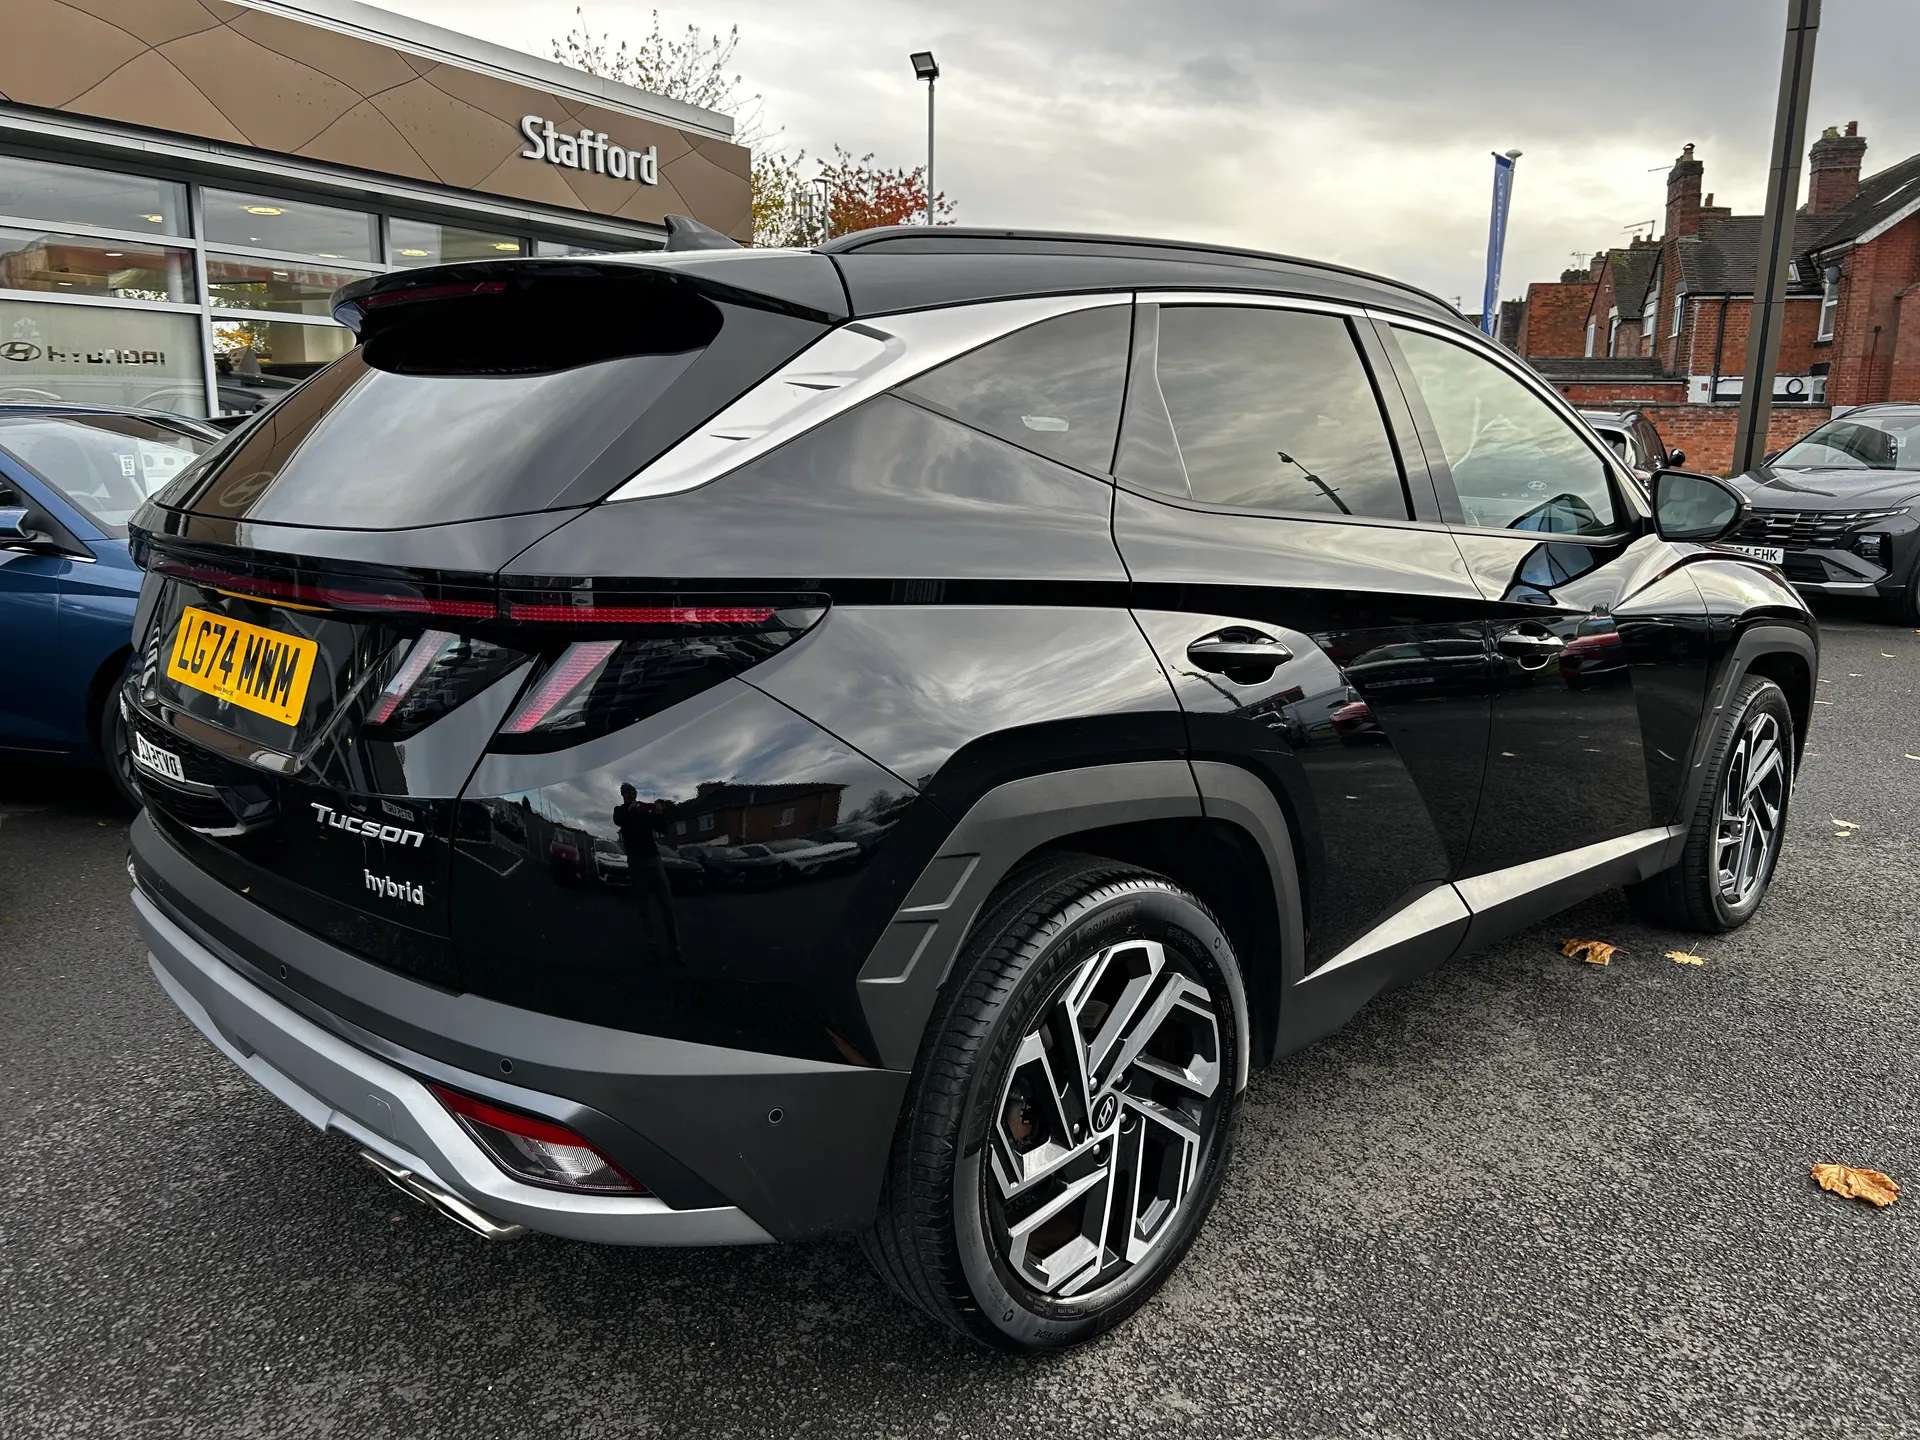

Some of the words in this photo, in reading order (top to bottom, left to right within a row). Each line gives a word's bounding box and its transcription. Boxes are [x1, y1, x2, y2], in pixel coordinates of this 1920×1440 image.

[521, 115, 658, 185] Stafford
[177, 615, 240, 685] LG74
[236, 633, 301, 708] MWM
[363, 868, 425, 906] hybrid
